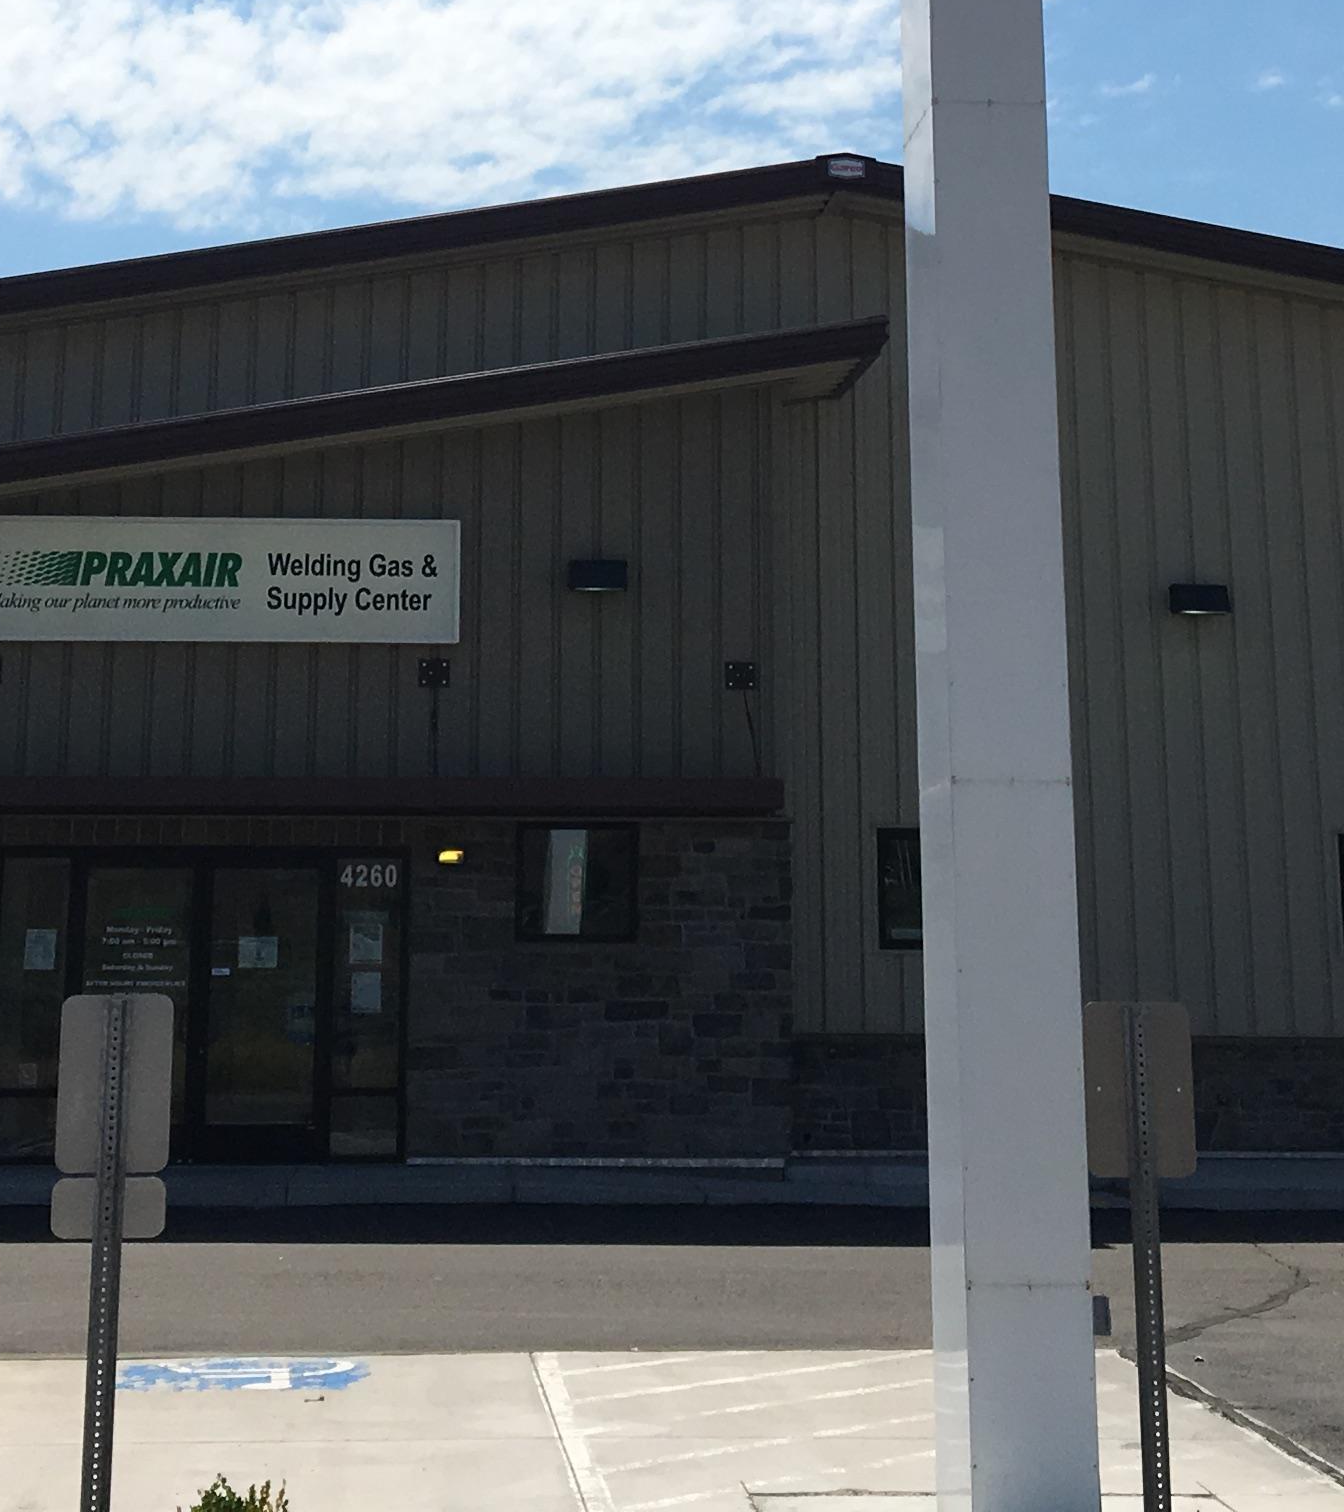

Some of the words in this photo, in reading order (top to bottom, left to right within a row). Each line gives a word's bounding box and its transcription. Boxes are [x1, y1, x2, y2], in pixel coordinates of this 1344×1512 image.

[79, 550, 242, 587] PRAXAIR
[267, 552, 361, 581] Welding
[368, 554, 413, 578] Gas
[420, 554, 438, 578] &
[44, 596, 72, 609] our
[72, 592, 120, 613] planet
[123, 596, 161, 610] more
[162, 593, 240, 613] productive
[266, 586, 346, 616] Supply
[355, 587, 432, 611] Center
[340, 864, 398, 888] 4260
[106, 926, 139, 936] Monday
[146, 926, 173, 935] Friday
[122, 952, 154, 960] CLOSED
